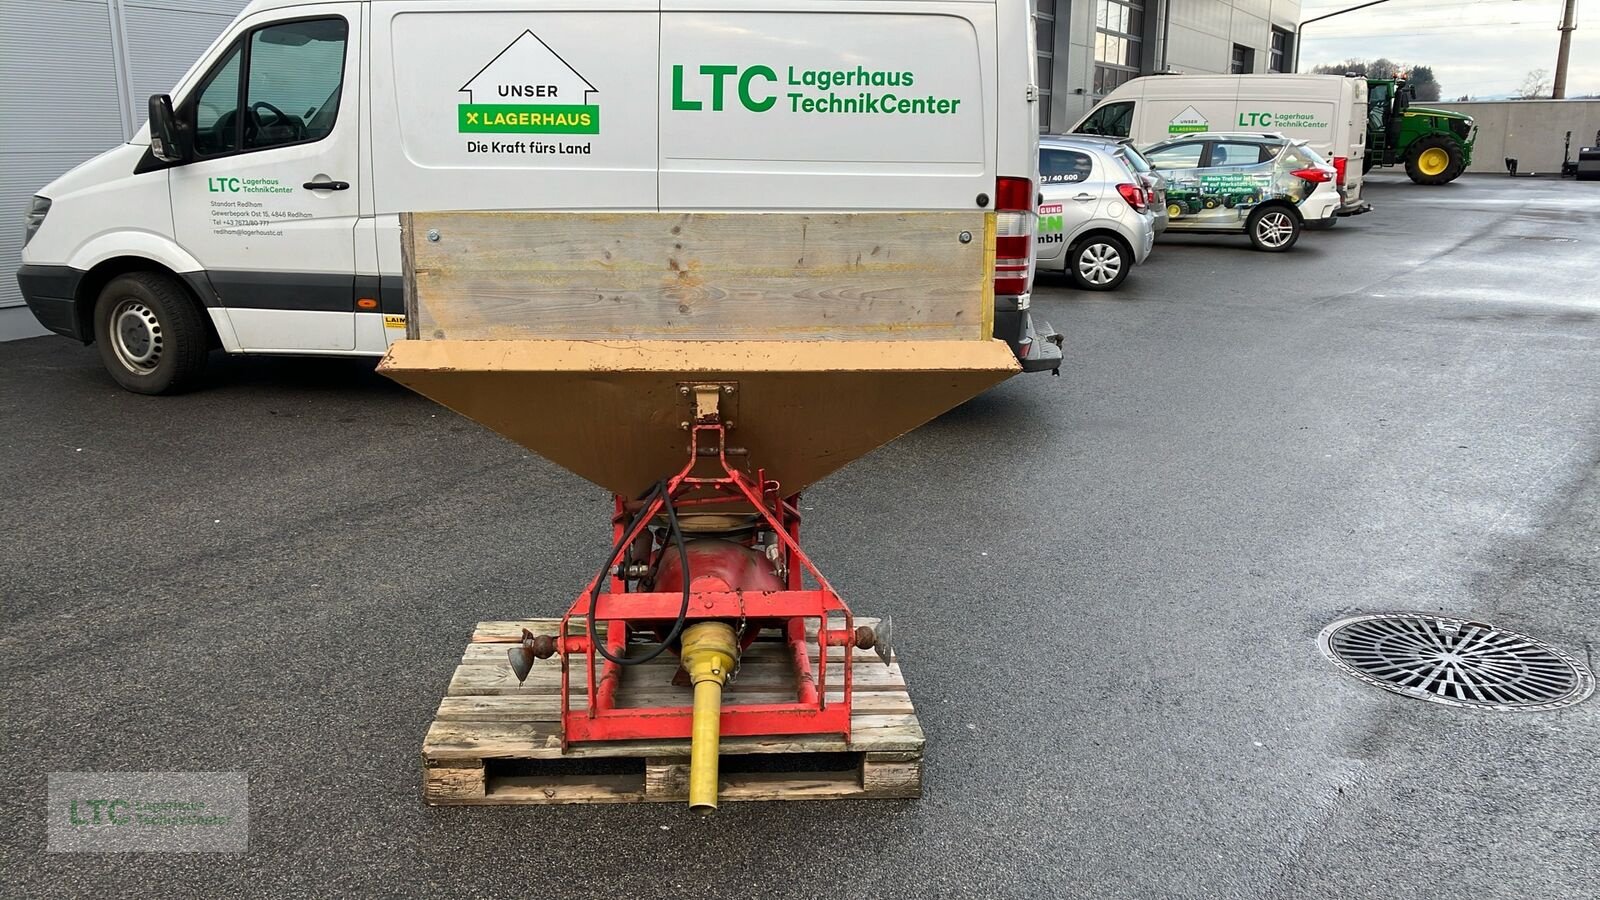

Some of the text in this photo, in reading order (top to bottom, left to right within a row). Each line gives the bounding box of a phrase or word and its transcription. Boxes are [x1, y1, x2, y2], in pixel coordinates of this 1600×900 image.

[787, 65, 914, 90] Lagerhaus
[498, 85, 558, 97] UNSER
[672, 64, 778, 113] LTC
[787, 92, 961, 114] TechnikCenter
[483, 112, 591, 126] LAGERHAUS
[1239, 112, 1272, 127] LTC
[1275, 113, 1314, 121] Lagerhaus
[1274, 120, 1328, 128] TechnikCenter
[467, 141, 591, 154] Die Kraft fürs Land
[208, 177, 240, 193] LTC
[242, 178, 279, 186] Lagerhaus
[242, 186, 293, 194] TechnikCenter
[211, 210, 250, 218] Gewerbepark
